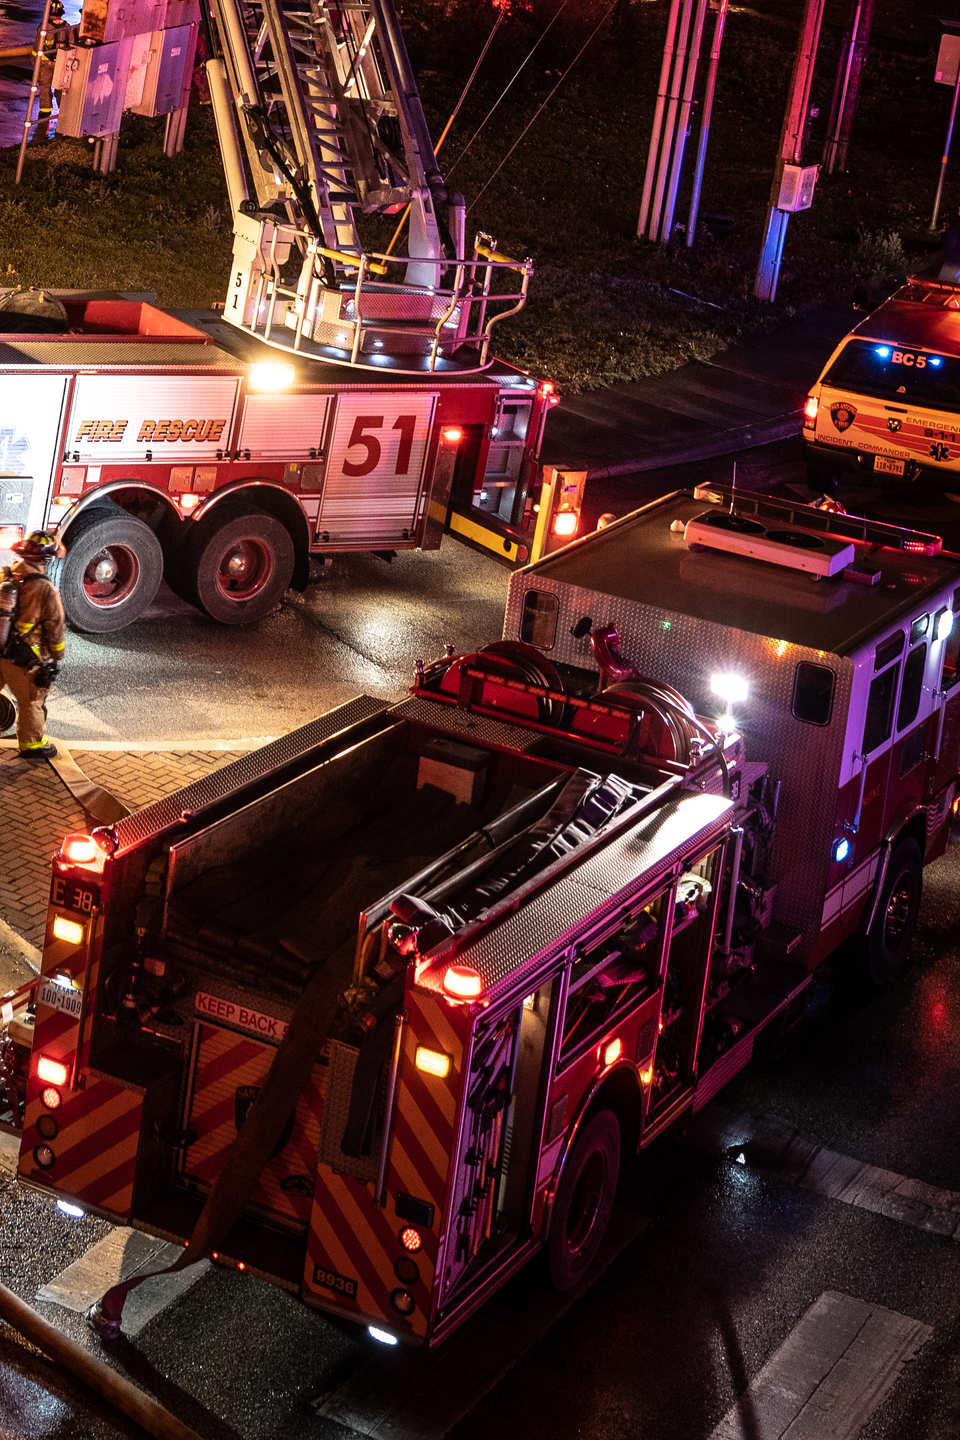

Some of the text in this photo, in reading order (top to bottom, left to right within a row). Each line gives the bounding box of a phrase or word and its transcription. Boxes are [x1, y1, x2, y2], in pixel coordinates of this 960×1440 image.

[75, 420, 227, 442] FIRE RESCUE
[342, 415, 416, 477] 51
[817, 434, 911, 458] INCIDENT COMMANDER
[51, 877, 93, 912] E 38
[197, 993, 235, 1019] KEEP
[238, 1009, 278, 1036] BACK
[237, 1087, 256, 1100] SAN
[316, 1269, 355, 1295] 8936
